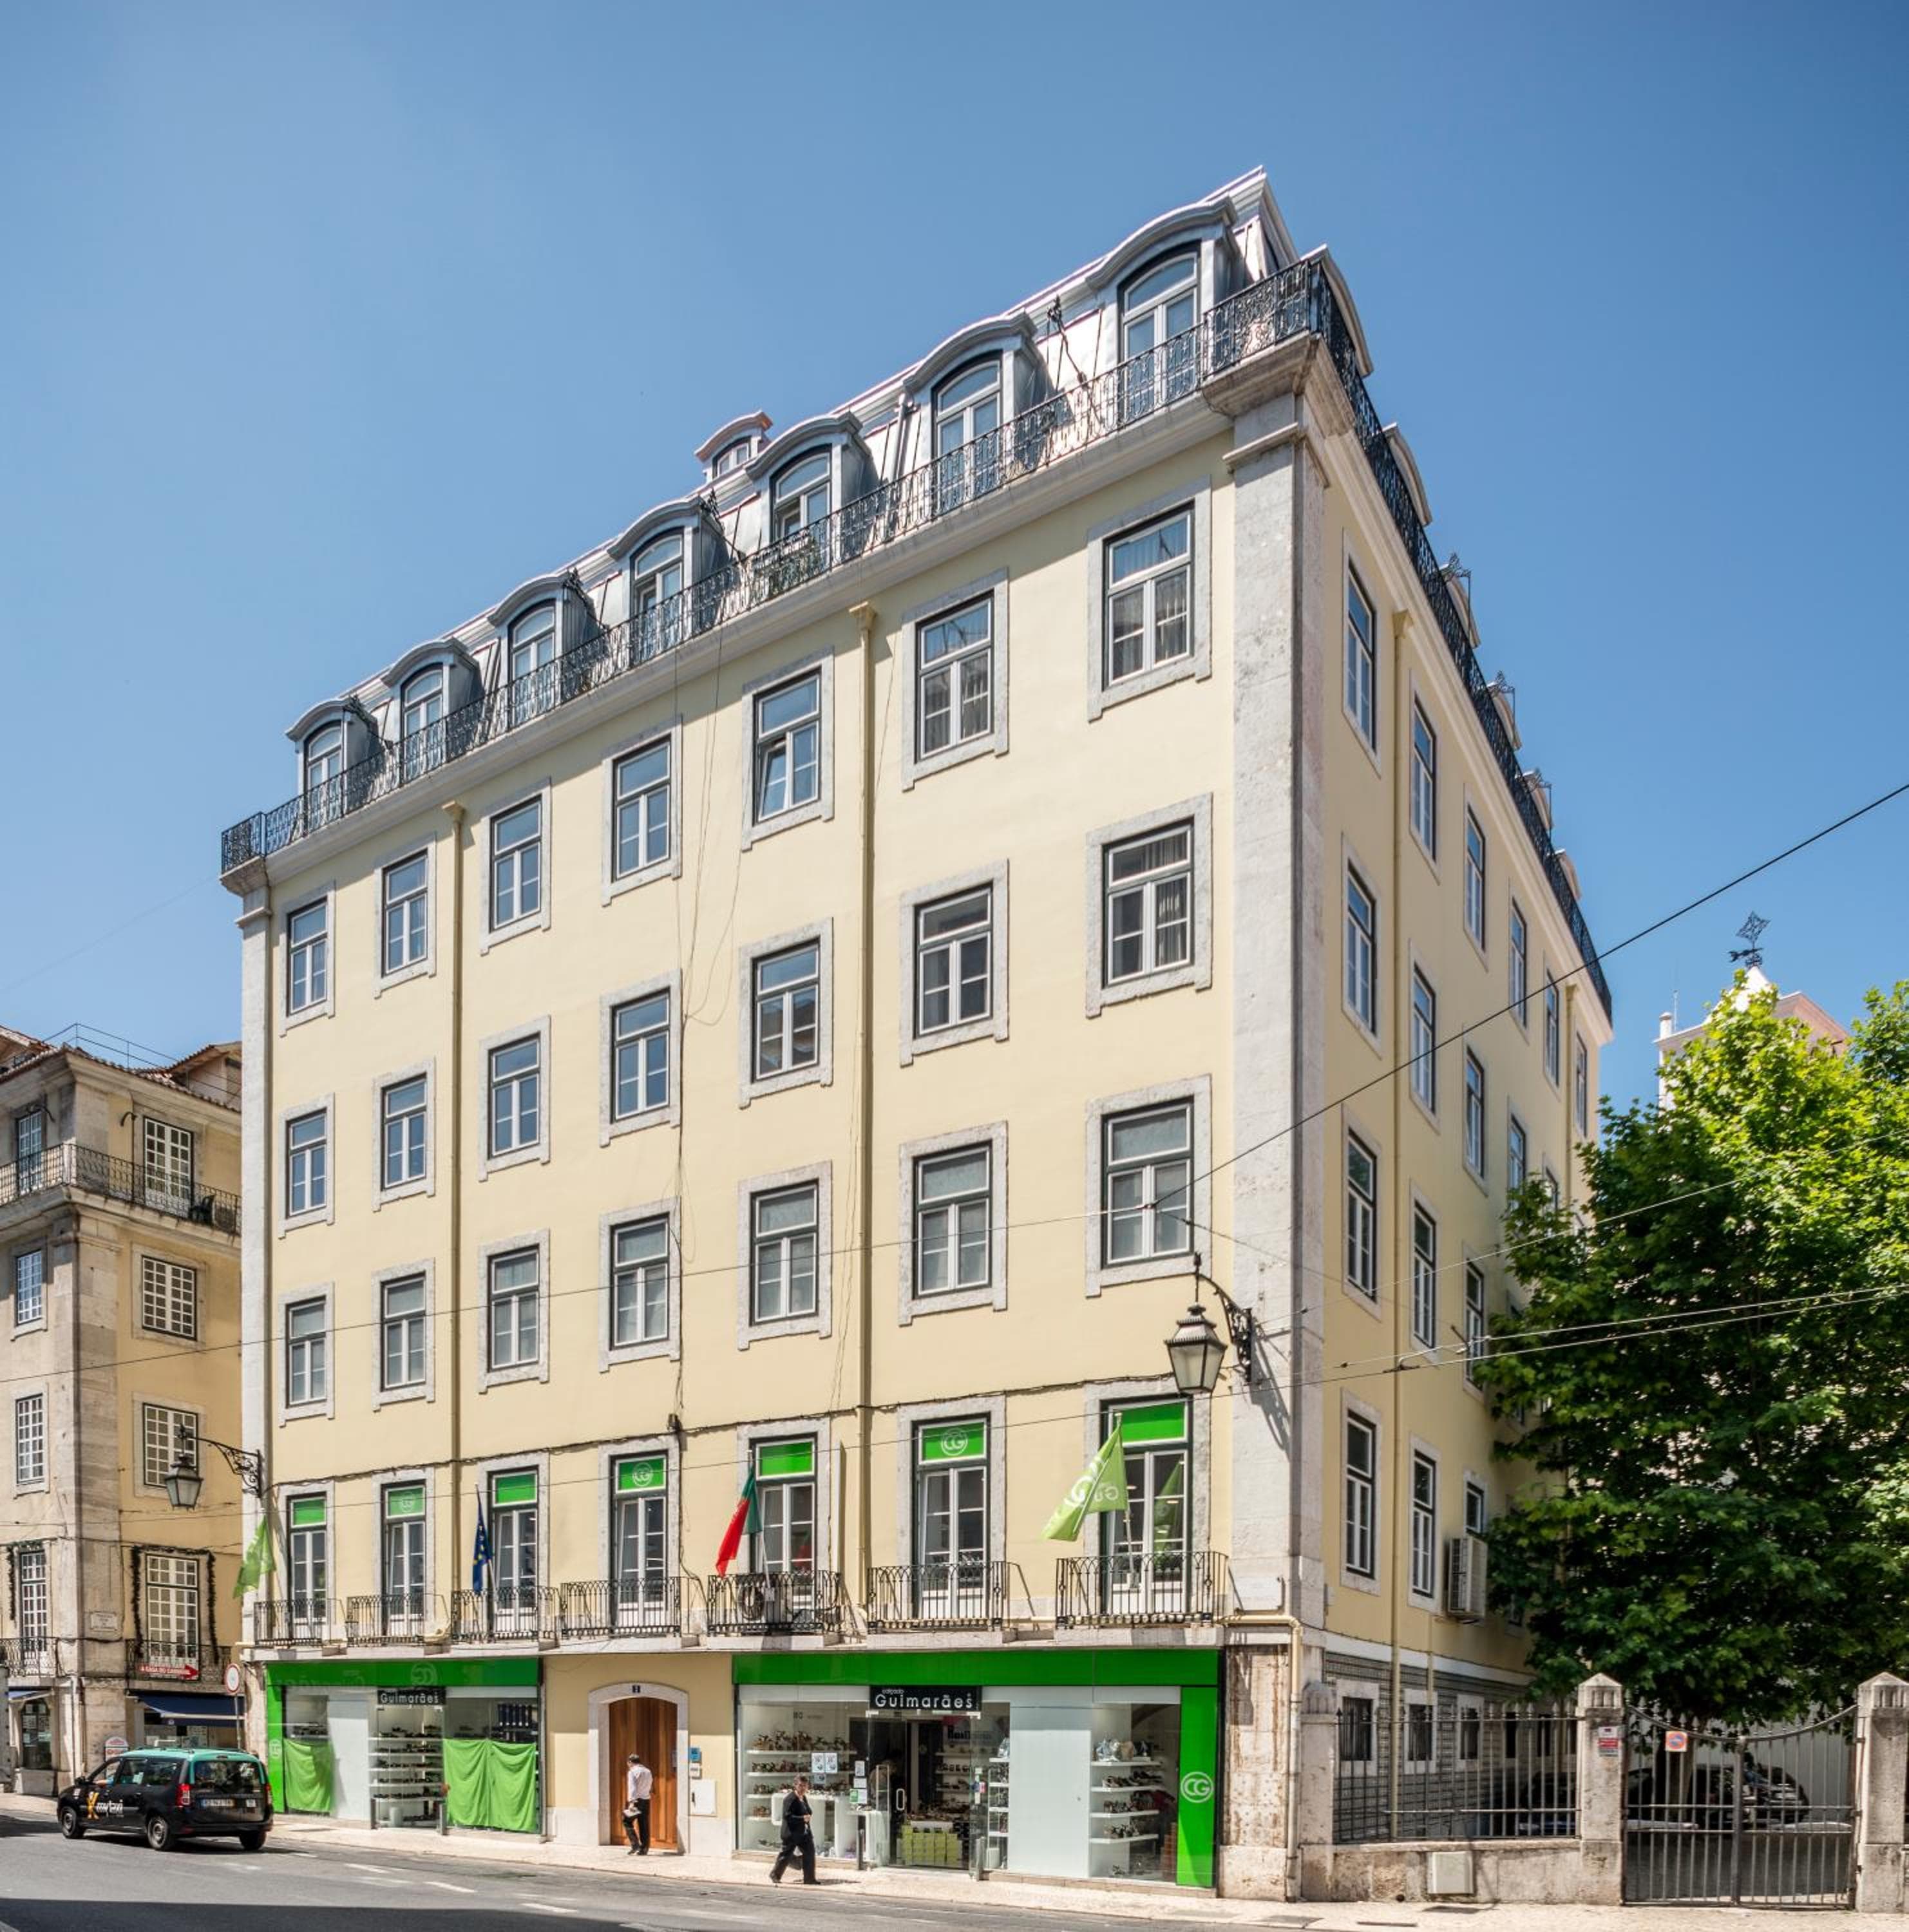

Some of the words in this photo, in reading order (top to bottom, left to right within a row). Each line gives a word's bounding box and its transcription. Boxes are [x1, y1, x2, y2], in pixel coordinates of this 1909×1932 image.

[381, 1692, 439, 1704] Guimarães
[875, 1693, 973, 1709] Guimarães
[1184, 1777, 1211, 1797] CG
